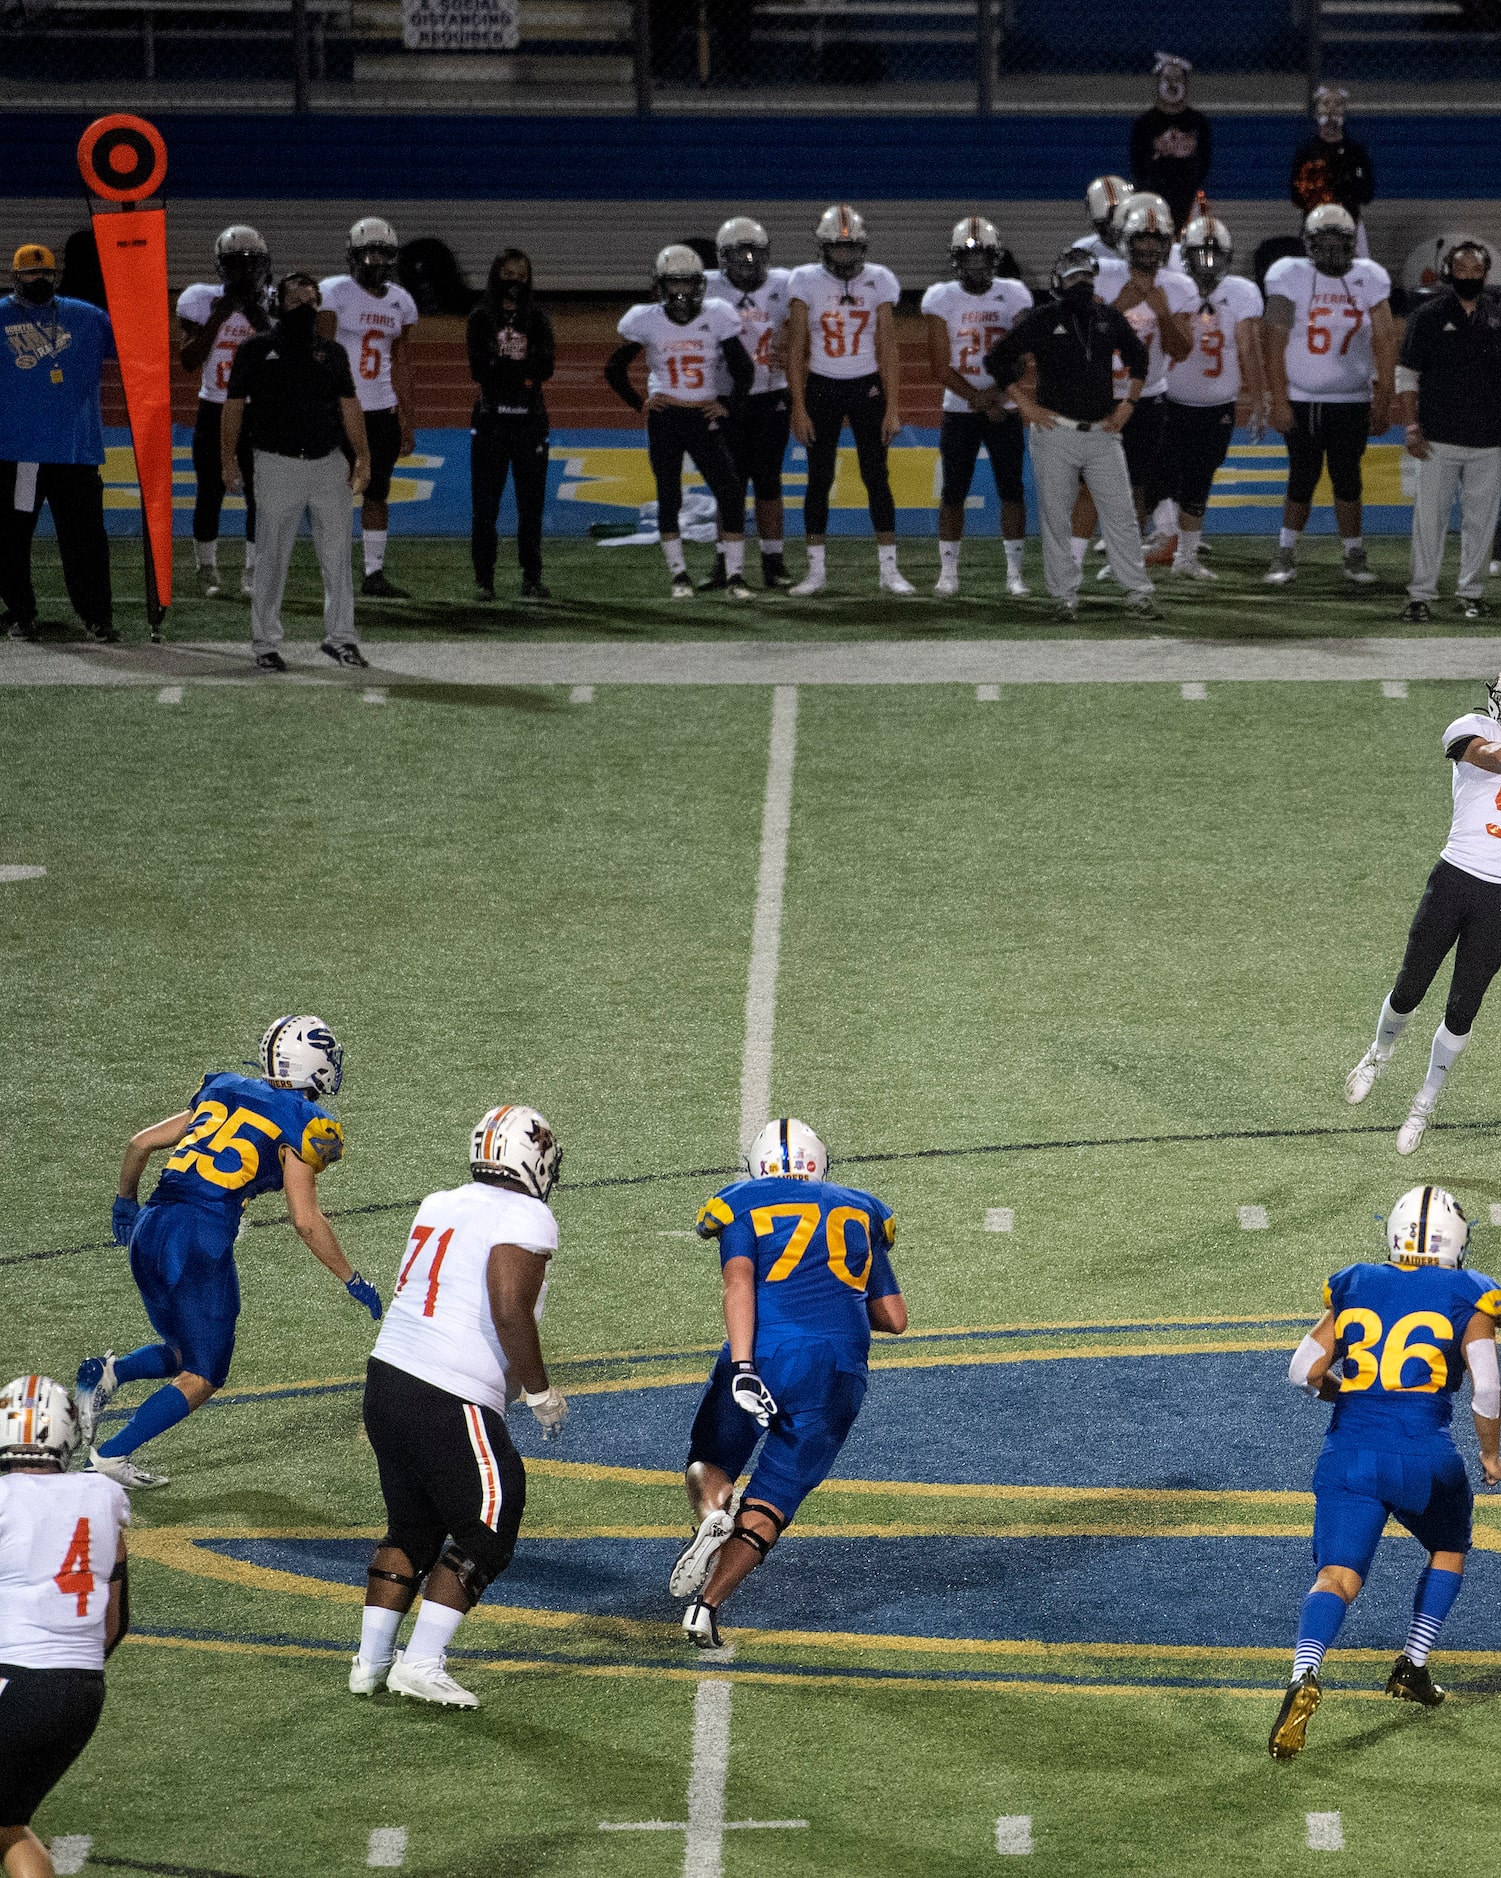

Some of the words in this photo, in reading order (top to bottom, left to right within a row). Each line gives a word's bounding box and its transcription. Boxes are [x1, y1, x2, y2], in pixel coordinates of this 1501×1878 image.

[411, 13, 512, 26] DISTANCING
[420, 32, 503, 43] REQUIRED
[359, 313, 396, 328] FERRIS
[819, 310, 870, 358] 87
[1307, 307, 1363, 355] 67
[360, 329, 384, 380] 6
[665, 355, 705, 389] 15
[165, 1100, 284, 1191] 25
[396, 1224, 456, 1318] 71
[749, 1202, 873, 1293] 70
[1399, 1254, 1440, 1267] RAIDERS
[1333, 1307, 1455, 1394] 36
[53, 1516, 95, 1617] 4
